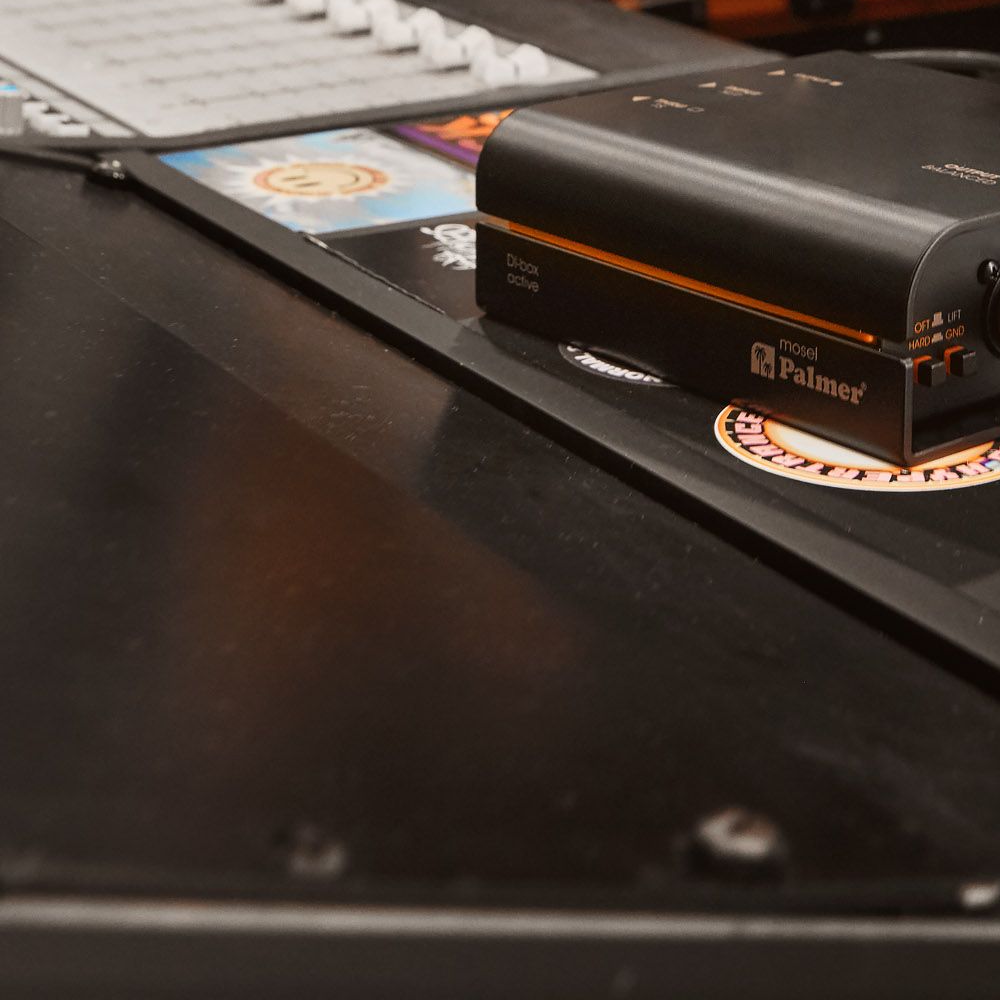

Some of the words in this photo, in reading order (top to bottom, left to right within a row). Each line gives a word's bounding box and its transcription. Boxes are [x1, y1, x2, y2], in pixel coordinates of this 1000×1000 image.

[507, 273, 539, 293] active
[947, 308, 961, 323] LIFT
[908, 335, 931, 351] HARD
[945, 324, 965, 340] GND
[780, 338, 818, 361] mosel
